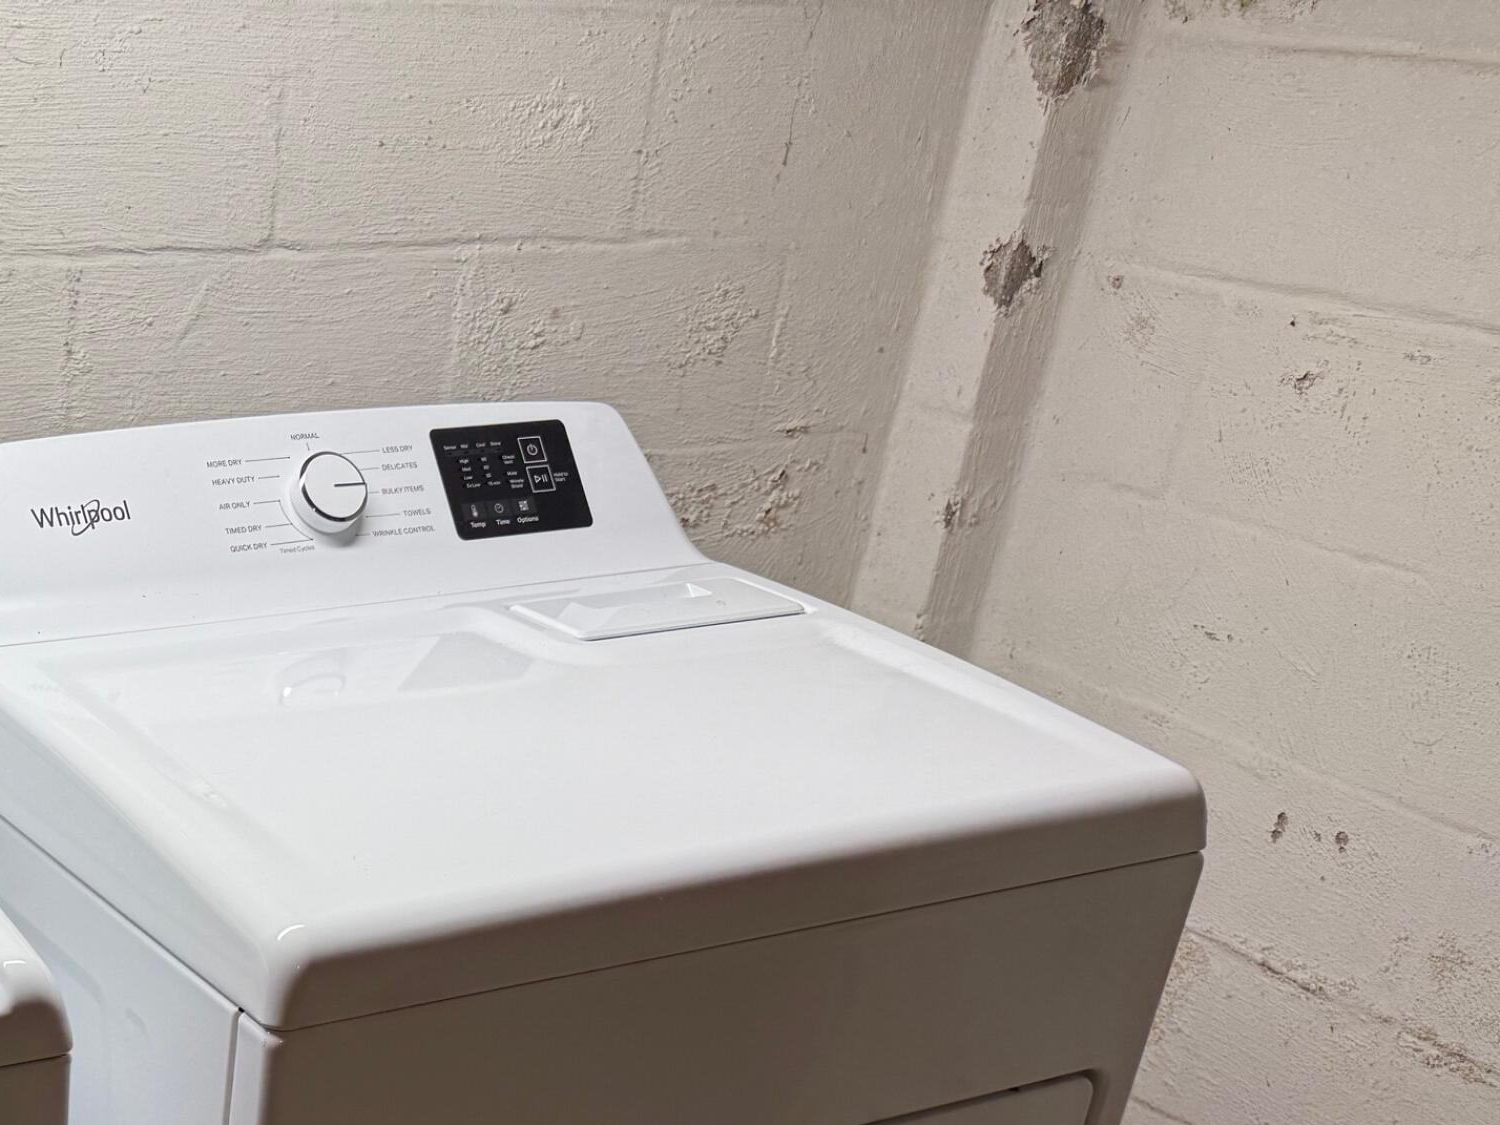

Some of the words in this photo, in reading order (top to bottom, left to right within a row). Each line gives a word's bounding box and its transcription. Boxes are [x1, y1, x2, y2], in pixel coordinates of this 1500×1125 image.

[289, 432, 320, 441] NORMAL
[382, 446, 398, 454] LESS
[398, 445, 413, 453] DRY
[206, 460, 225, 468] MORE
[226, 458, 242, 467] DRY
[381, 461, 418, 471] DELICATES
[211, 476, 235, 486] HEAVY
[236, 475, 255, 484] DUTY
[381, 486, 403, 495] BULKY
[404, 484, 425, 493] ITEMS
[218, 502, 232, 510] AIR
[232, 500, 251, 509] ONLY
[30, 499, 131, 536] Whirlpool
[403, 508, 432, 517] TOWELS
[517, 516, 540, 524] Options
[225, 526, 247, 535] TIMED
[247, 524, 262, 533] DRY
[372, 527, 402, 538] WRINKLE
[403, 525, 435, 536] CONTROL
[230, 544, 251, 553] QUICK
[253, 542, 268, 551] DRY
